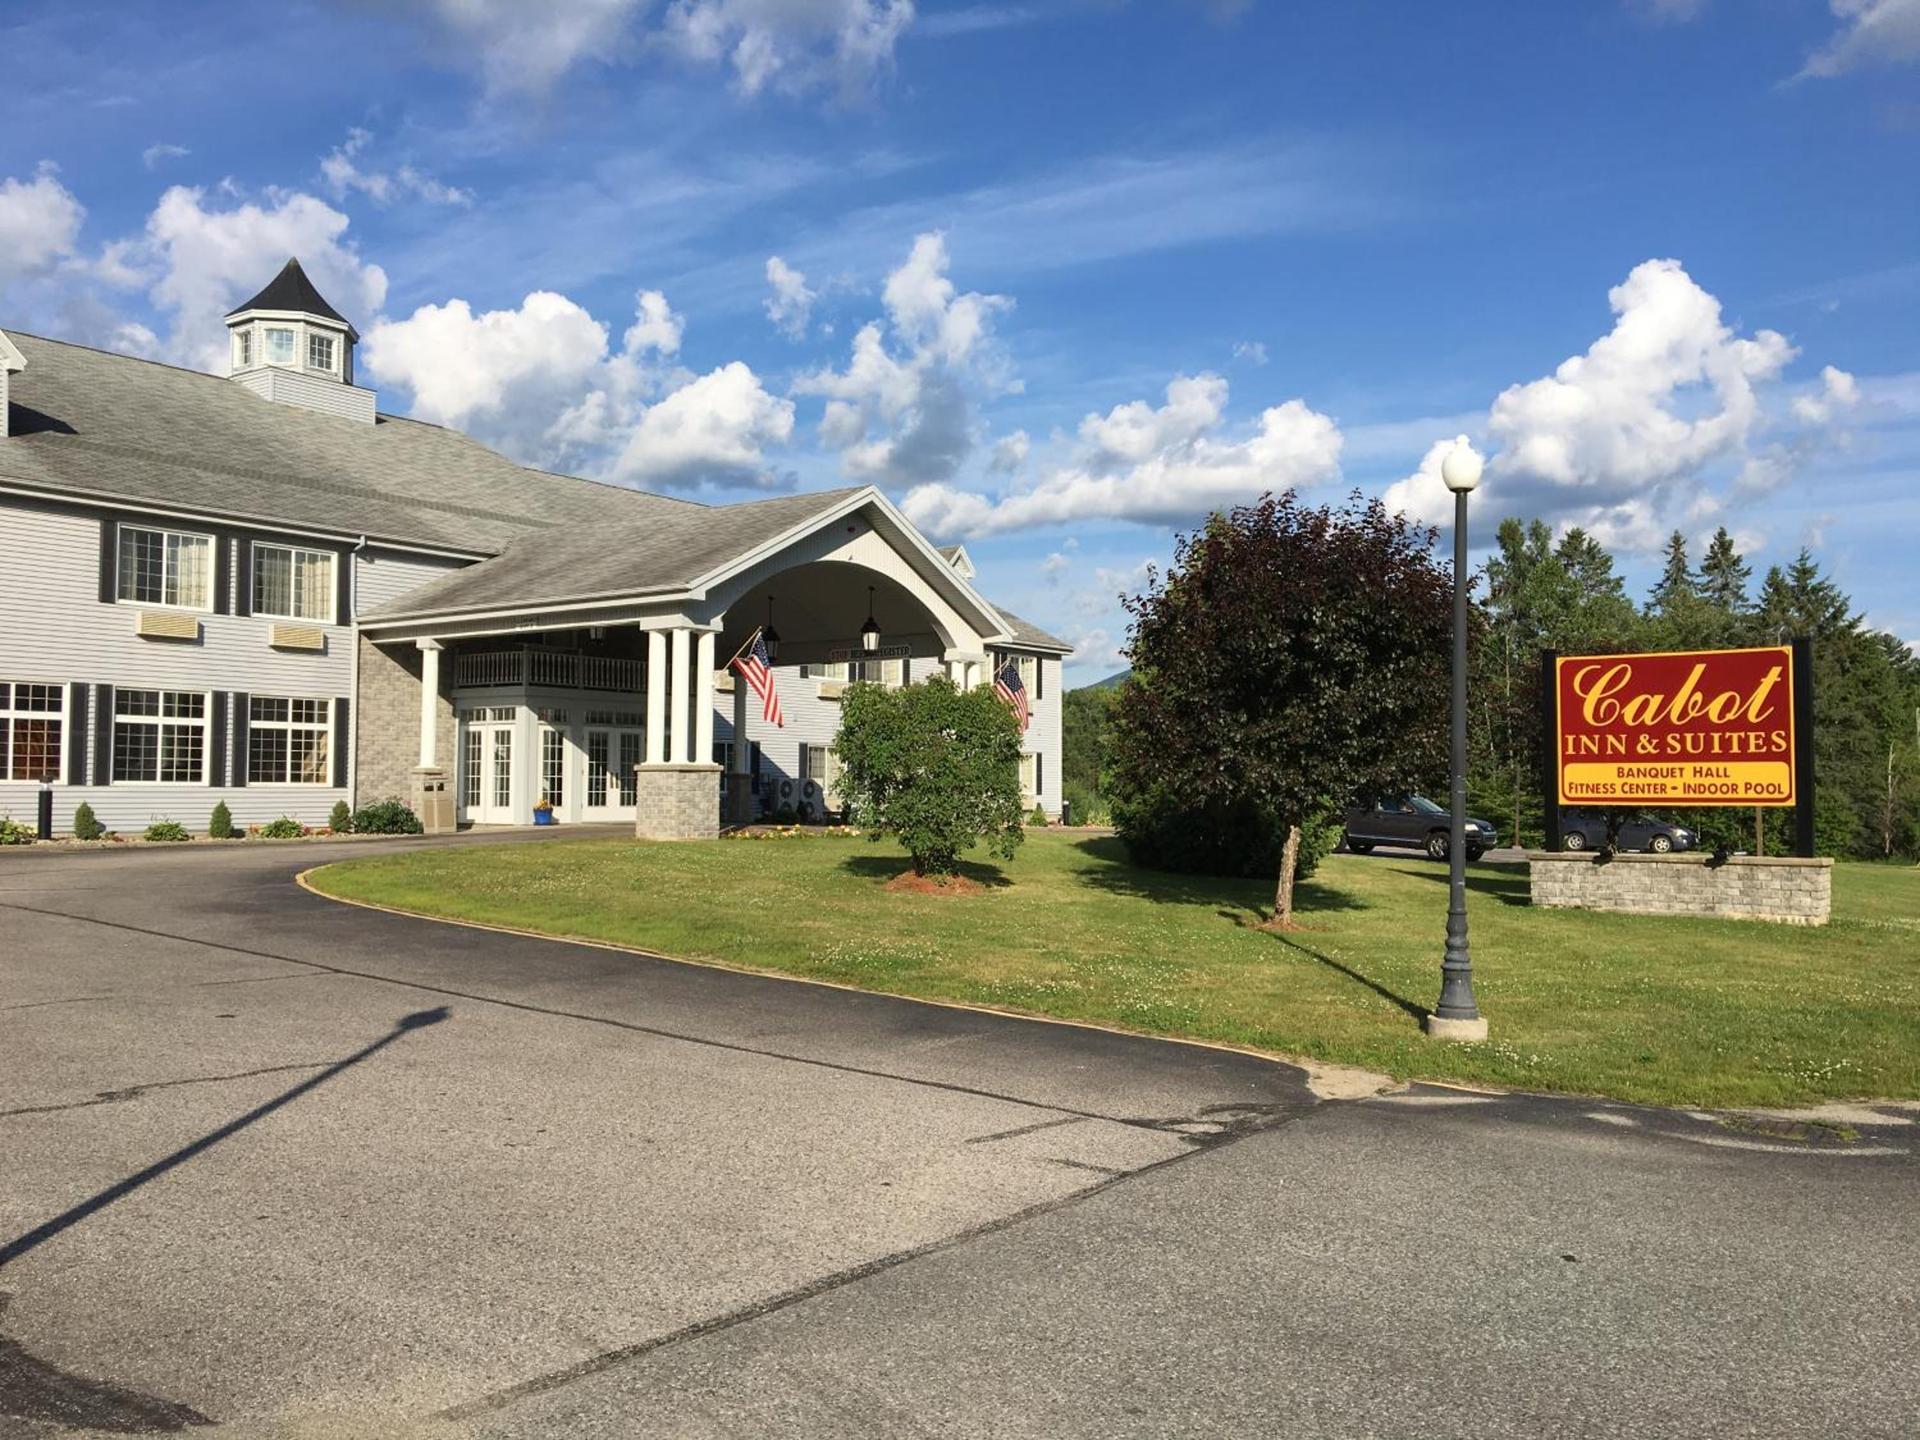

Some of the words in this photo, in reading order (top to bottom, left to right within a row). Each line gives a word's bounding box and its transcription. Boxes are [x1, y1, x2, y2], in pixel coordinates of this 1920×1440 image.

[1573, 664, 1783, 727] Cabot
[1565, 735, 1627, 755] INN
[1636, 734, 1660, 755] &
[1666, 730, 1788, 754] SUITES
[1616, 766, 1685, 779] BANQUET
[1692, 766, 1731, 778] HALL
[1568, 782, 1617, 794] FITNESS
[1620, 782, 1667, 794] CENTER
[1682, 782, 1739, 794] INDOOR
[1744, 782, 1784, 794] POOL
